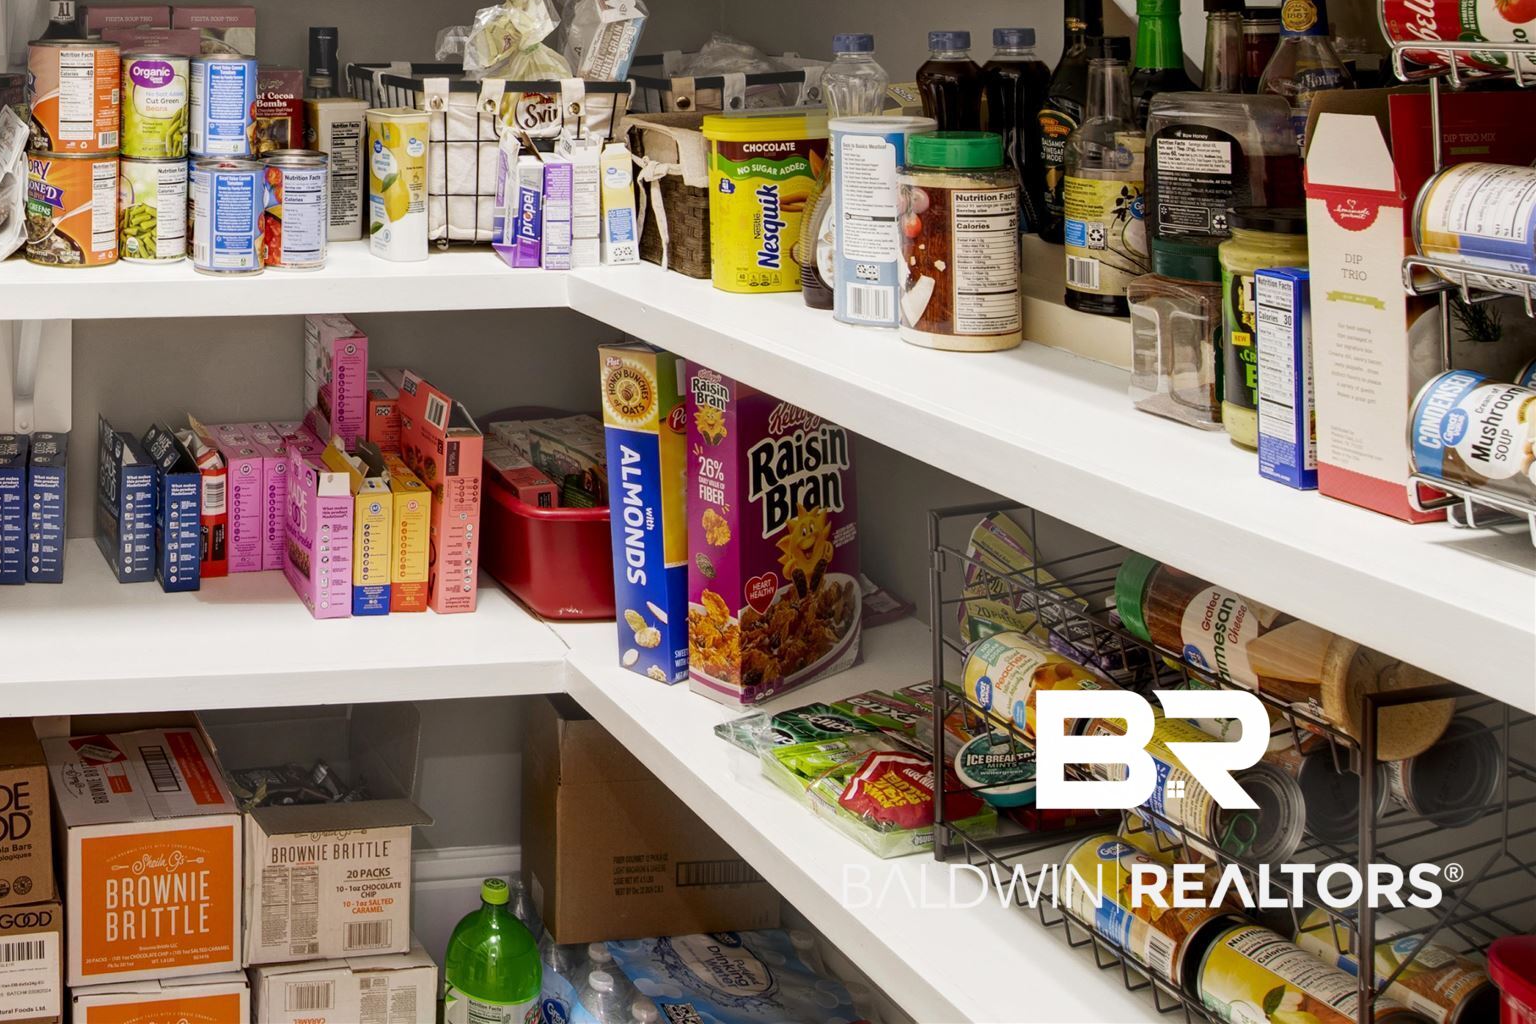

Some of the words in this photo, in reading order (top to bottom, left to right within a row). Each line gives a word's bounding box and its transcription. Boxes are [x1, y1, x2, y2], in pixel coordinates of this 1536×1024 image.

[132, 65, 170, 79] Organic
[145, 97, 159, 105] Cut
[160, 97, 180, 105] Green
[268, 91, 294, 100] Cocoa
[257, 99, 287, 108] Bombs
[1443, 134, 1458, 143] DIP
[1459, 134, 1479, 143] TRIO
[1480, 133, 1496, 142] MIX
[742, 142, 796, 153] CHOCOLATE
[736, 165, 751, 176] NO
[751, 163, 778, 176] SUGAR
[284, 174, 309, 182] Nutrition
[284, 196, 304, 204] Calories
[955, 193, 998, 203] Nutrition
[521, 189, 535, 238] propel
[756, 183, 788, 269] Nesquik
[956, 222, 990, 230] Calories
[1344, 253, 1364, 266] DIP
[1340, 267, 1368, 282] TRIO
[1257, 276, 1278, 288] Nutrition
[1277, 279, 1292, 292] Facts
[1258, 310, 1279, 323] Calories
[1283, 314, 1292, 326] 30
[1234, 334, 1248, 343] NEW
[606, 357, 621, 367] Post
[608, 370, 623, 395] HONEY
[623, 369, 649, 401] BUNCHES
[692, 378, 729, 401] Raisin
[696, 392, 726, 411] Bran
[621, 403, 646, 415] OATS
[1418, 373, 1477, 450] CONDENSED
[1470, 387, 1527, 463] Mushroom
[1494, 428, 1514, 462] SOUP
[698, 456, 724, 481] 26%
[750, 426, 849, 498] Raisin
[699, 484, 725, 507] FIBER
[764, 468, 844, 536] Bran
[619, 444, 648, 587] ALMONDS
[645, 507, 655, 531] with
[749, 588, 775, 600] HEALTHY
[752, 582, 772, 592] HEART
[1202, 592, 1221, 632] Grated
[1228, 604, 1248, 644] Cheese
[994, 653, 1027, 690] Peaches
[966, 754, 984, 767] ICE
[980, 769, 1023, 777] wintergreen
[7, 843, 32, 854] Bars
[271, 844, 329, 864] BROWNIE
[333, 840, 390, 860] BRITTLE
[132, 853, 167, 875] Sheila
[346, 869, 359, 879] 20
[360, 867, 391, 878] PACKS
[105, 870, 211, 910] BROWNIE
[336, 885, 344, 893] 10
[361, 881, 402, 892] CHOCOLATE
[360, 891, 377, 899] CHIP
[368, 897, 394, 907] SALTED
[351, 906, 384, 915] CARAMEL
[105, 902, 211, 943] BRITTLE
[129, 952, 157, 960] CHOCOLATE
[1256, 945, 1294, 964] Calories
[704, 957, 739, 988] Water
[707, 945, 749, 987] Drinking
[14, 1006, 35, 1014] Foods
